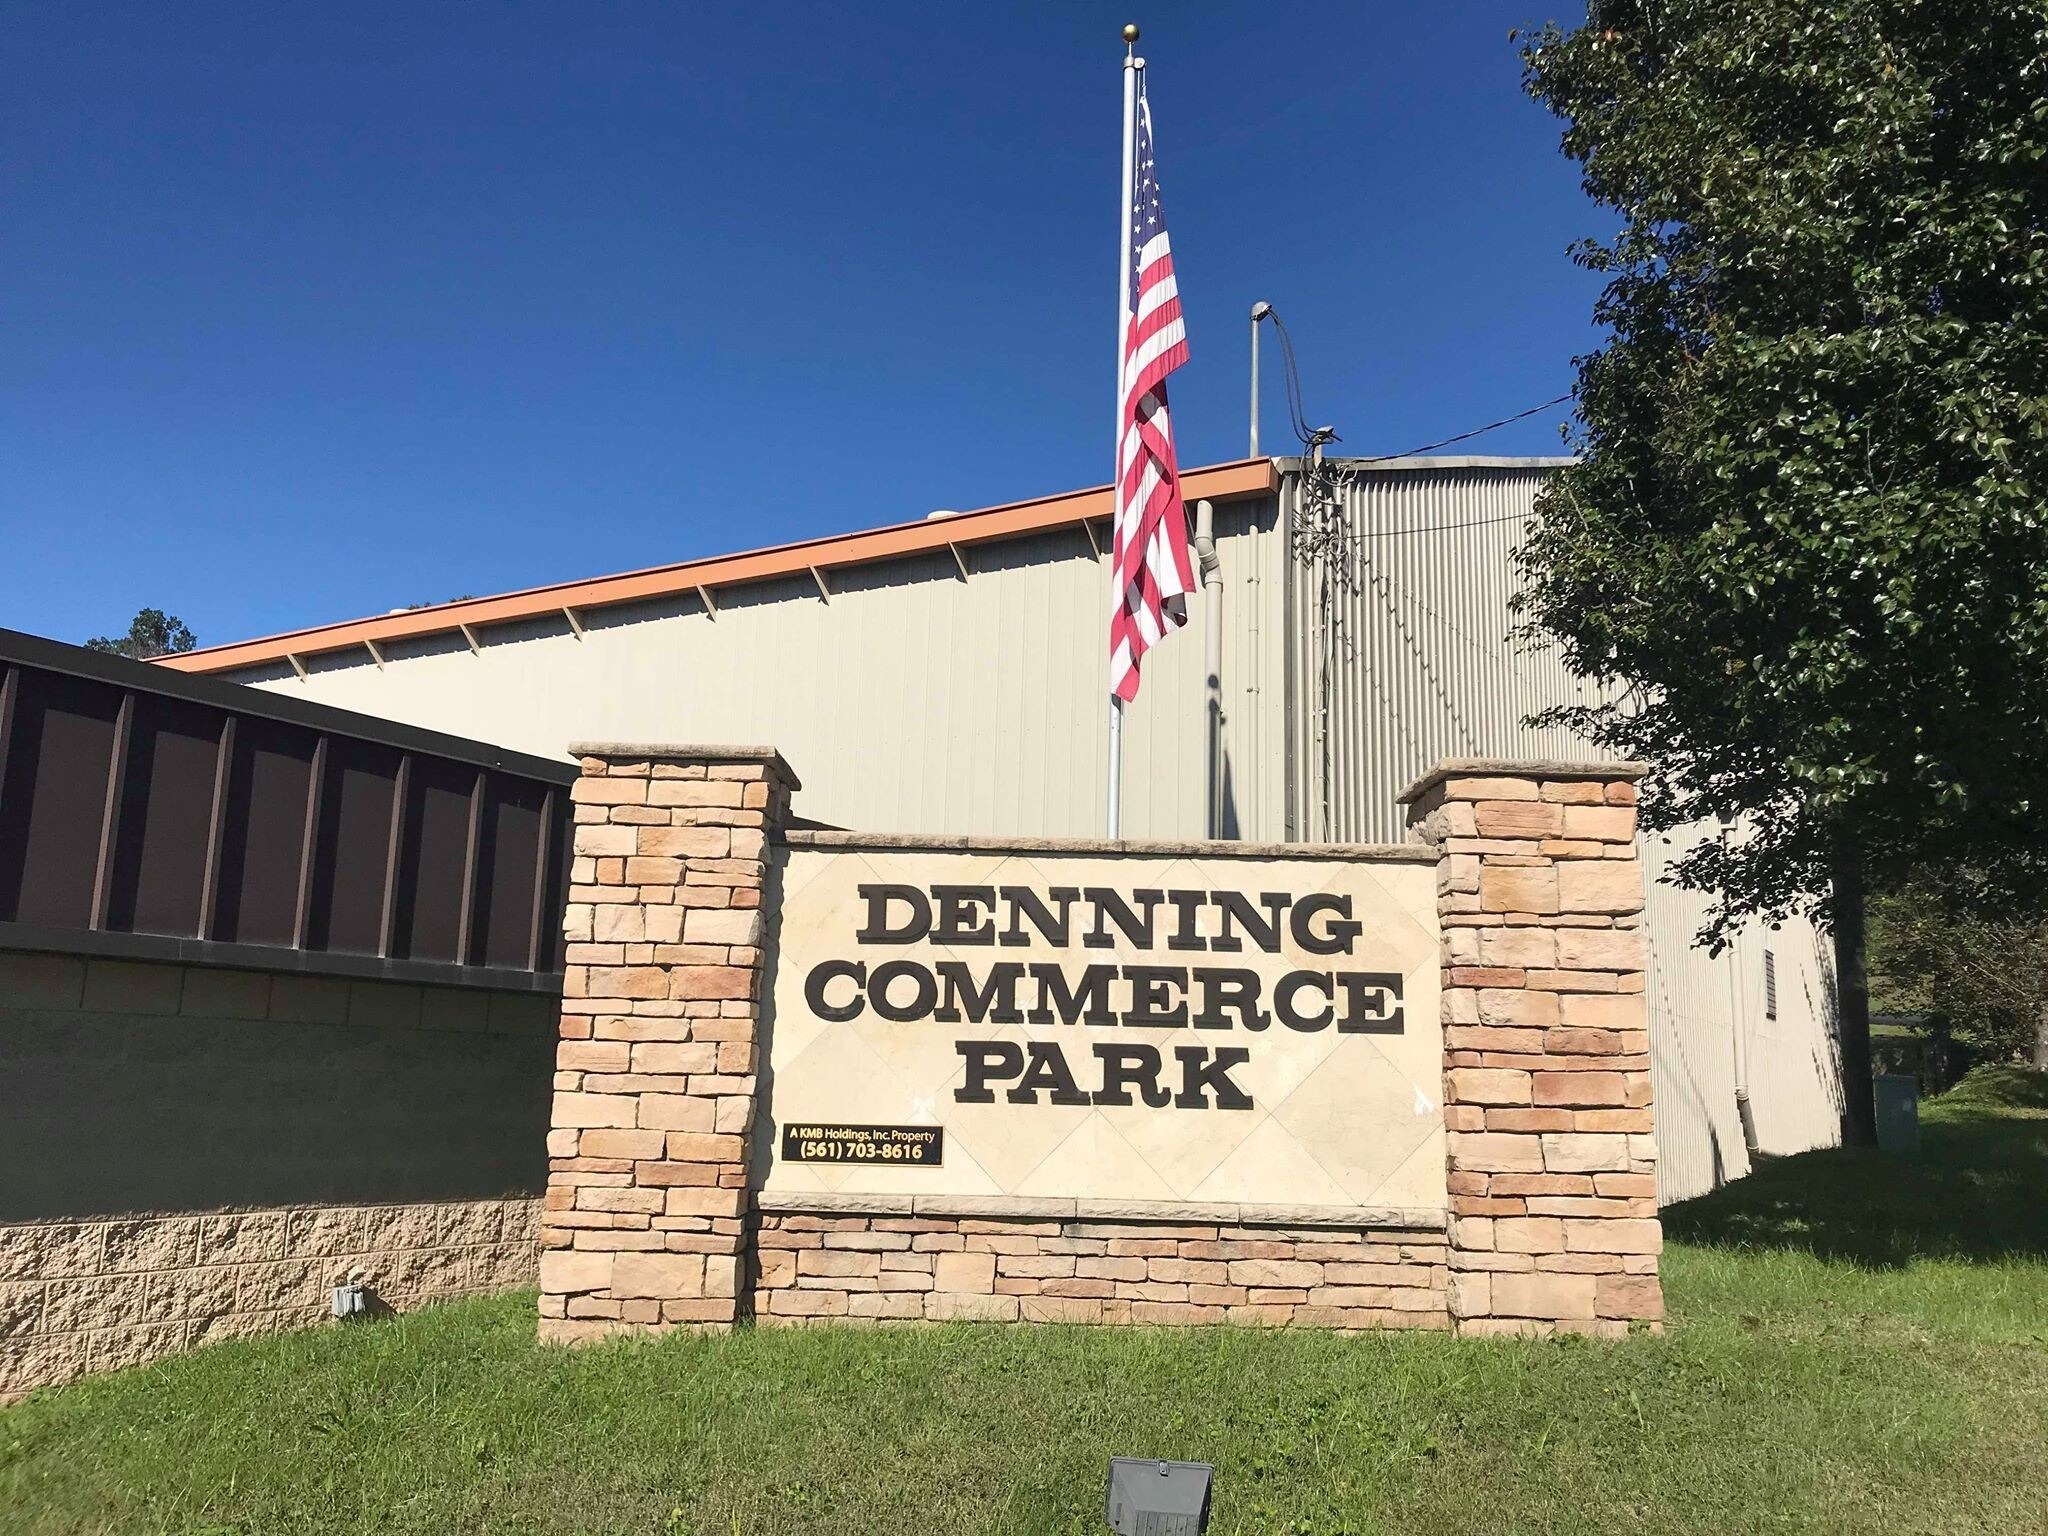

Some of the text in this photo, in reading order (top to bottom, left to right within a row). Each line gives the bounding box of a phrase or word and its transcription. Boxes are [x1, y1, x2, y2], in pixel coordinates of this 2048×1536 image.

[856, 884, 1363, 955] DENNING
[804, 960, 1405, 1035] COMMERCE
[954, 1040, 1254, 1110] PARK
[790, 1127, 935, 1143] A KMB Holdings, Inc. Property
[801, 1141, 922, 1159] (561) 703-8616
